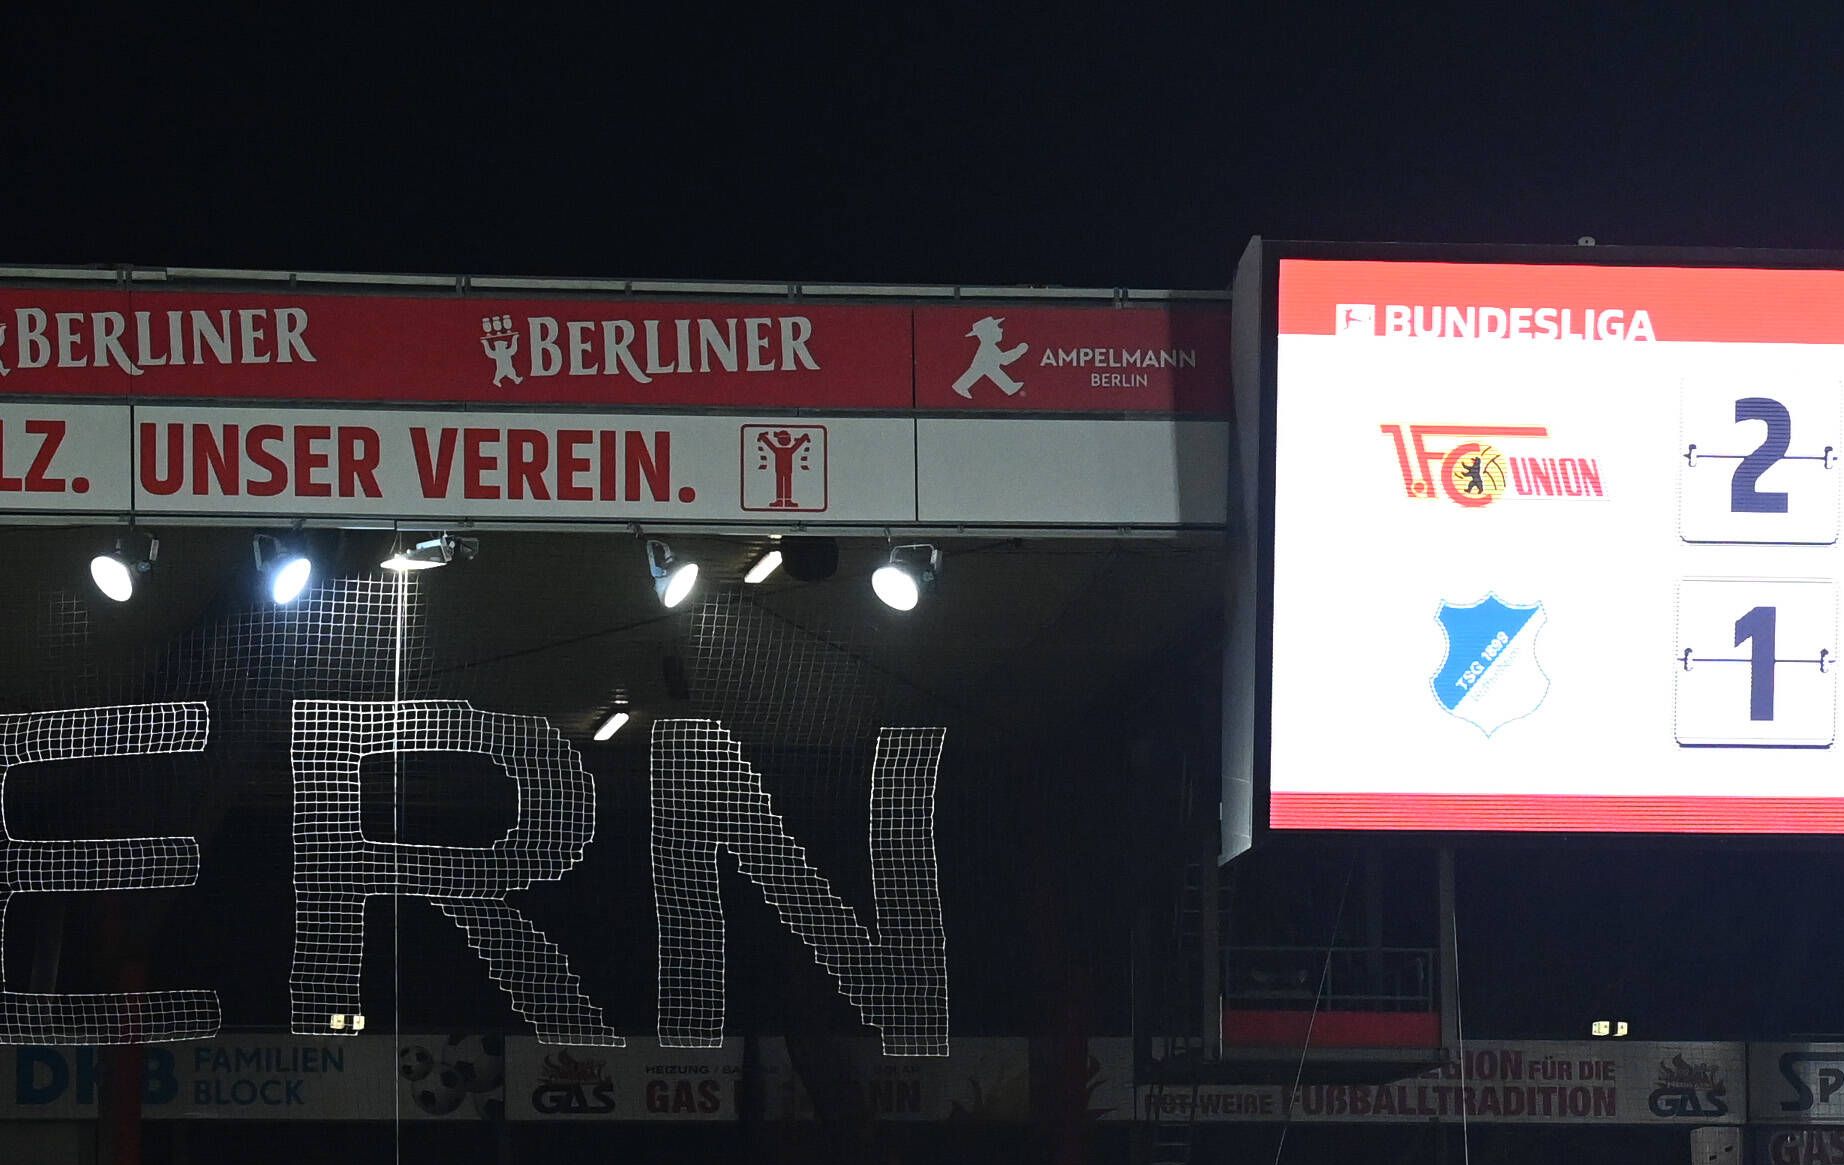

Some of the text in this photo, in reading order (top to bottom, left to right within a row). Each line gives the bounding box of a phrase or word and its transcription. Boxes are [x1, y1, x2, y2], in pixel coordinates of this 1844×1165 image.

[15, 307, 317, 376] BERLINER
[1385, 304, 1656, 341] BUNDESLIGA
[529, 316, 821, 384] BERLINER
[1040, 347, 1196, 369] AMPELMANN
[1091, 373, 1148, 387] BERLIN
[139, 422, 383, 498] UNSER
[409, 426, 696, 503] VEREIN.
[1730, 397, 1792, 514] 2
[1509, 456, 1604, 497] UNION
[1733, 606, 1776, 722] 1
[193, 1046, 345, 1073] FAMILIEN
[1529, 1055, 1574, 1081] FÜR
[1579, 1060, 1616, 1081] DIE
[193, 1078, 305, 1105] BLOCK
